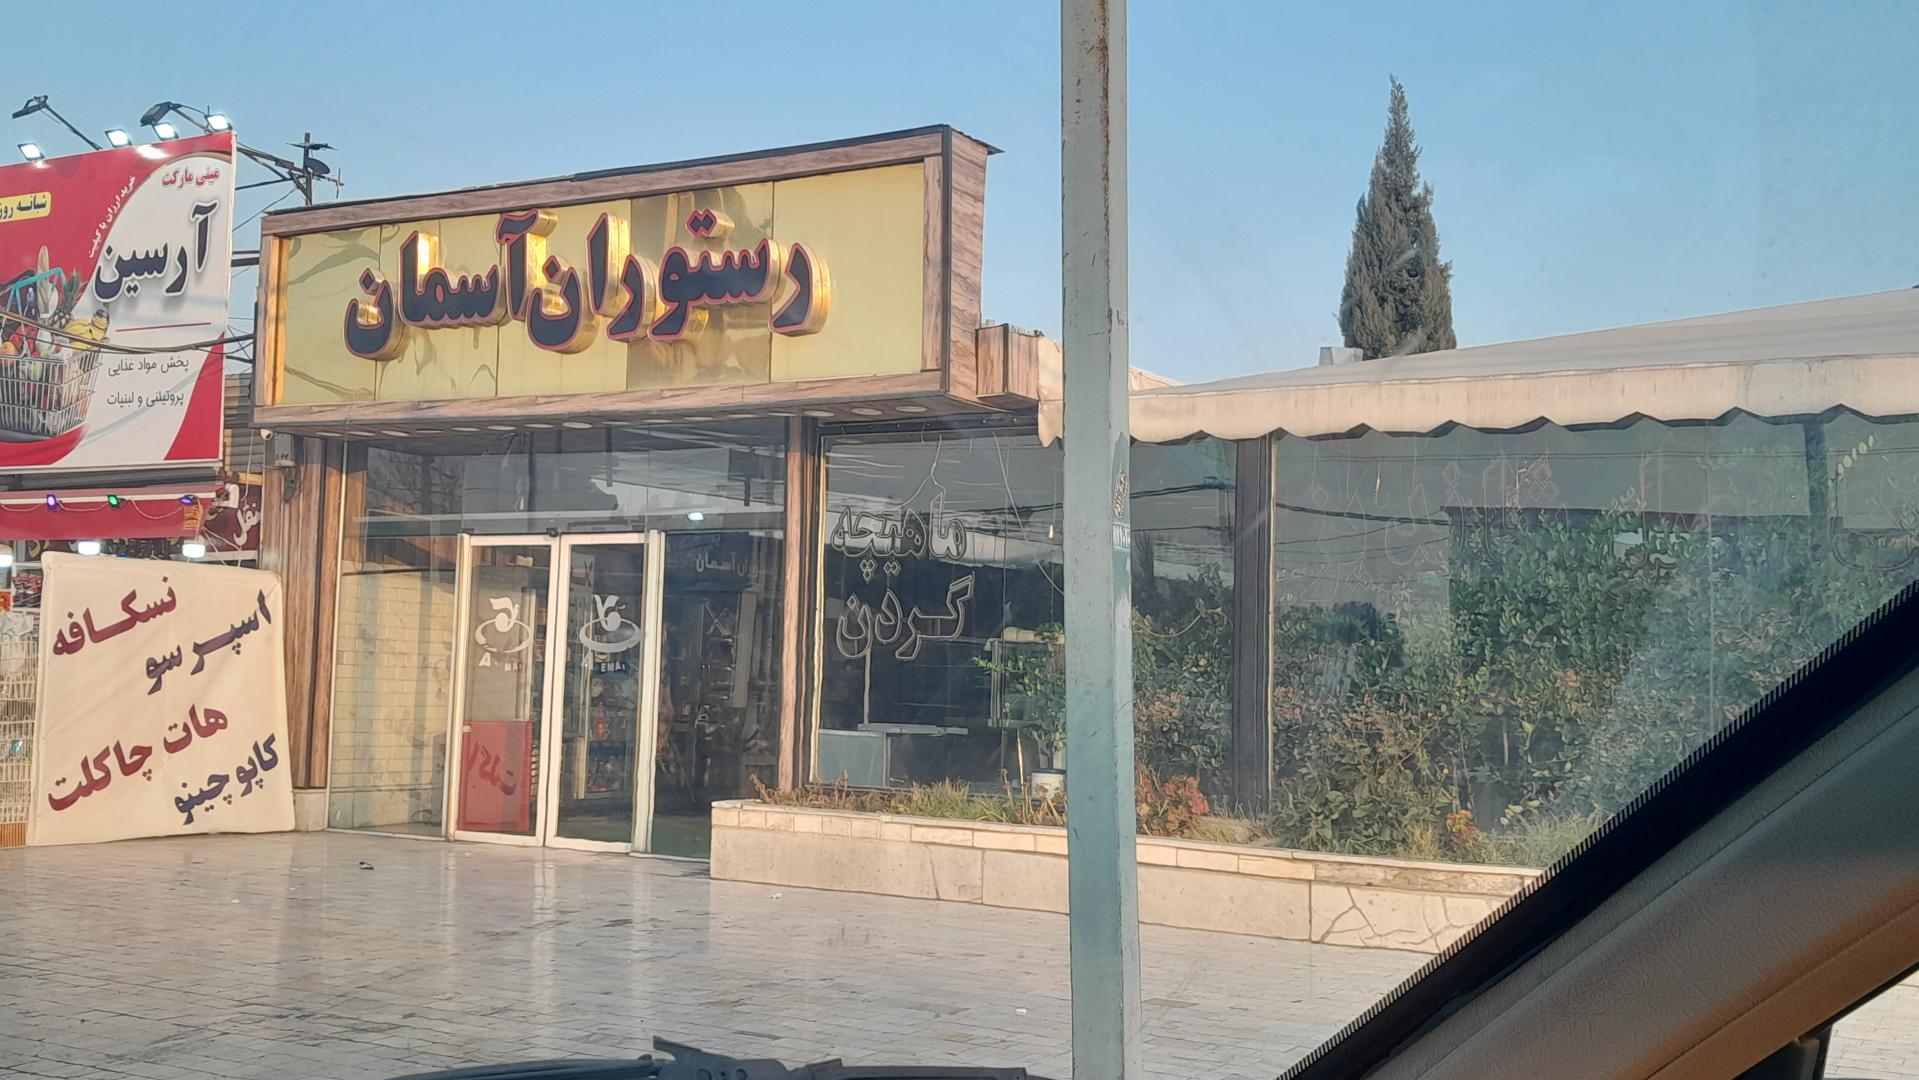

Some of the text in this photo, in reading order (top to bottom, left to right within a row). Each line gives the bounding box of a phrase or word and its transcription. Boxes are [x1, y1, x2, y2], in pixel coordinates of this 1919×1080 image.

[162, 166, 220, 189] مینی مارکت
[16, 194, 48, 214] شبانه
[96, 202, 218, 298] آرسین
[343, 208, 826, 362] رستوران آسمان
[108, 355, 189, 377] پخش مواد غذایی
[106, 391, 134, 408] لبنیات
[137, 395, 143, 408] و
[53, 576, 177, 656] نسکافه
[836, 571, 976, 660] گردن
[48, 703, 229, 811] هات چاکلت
